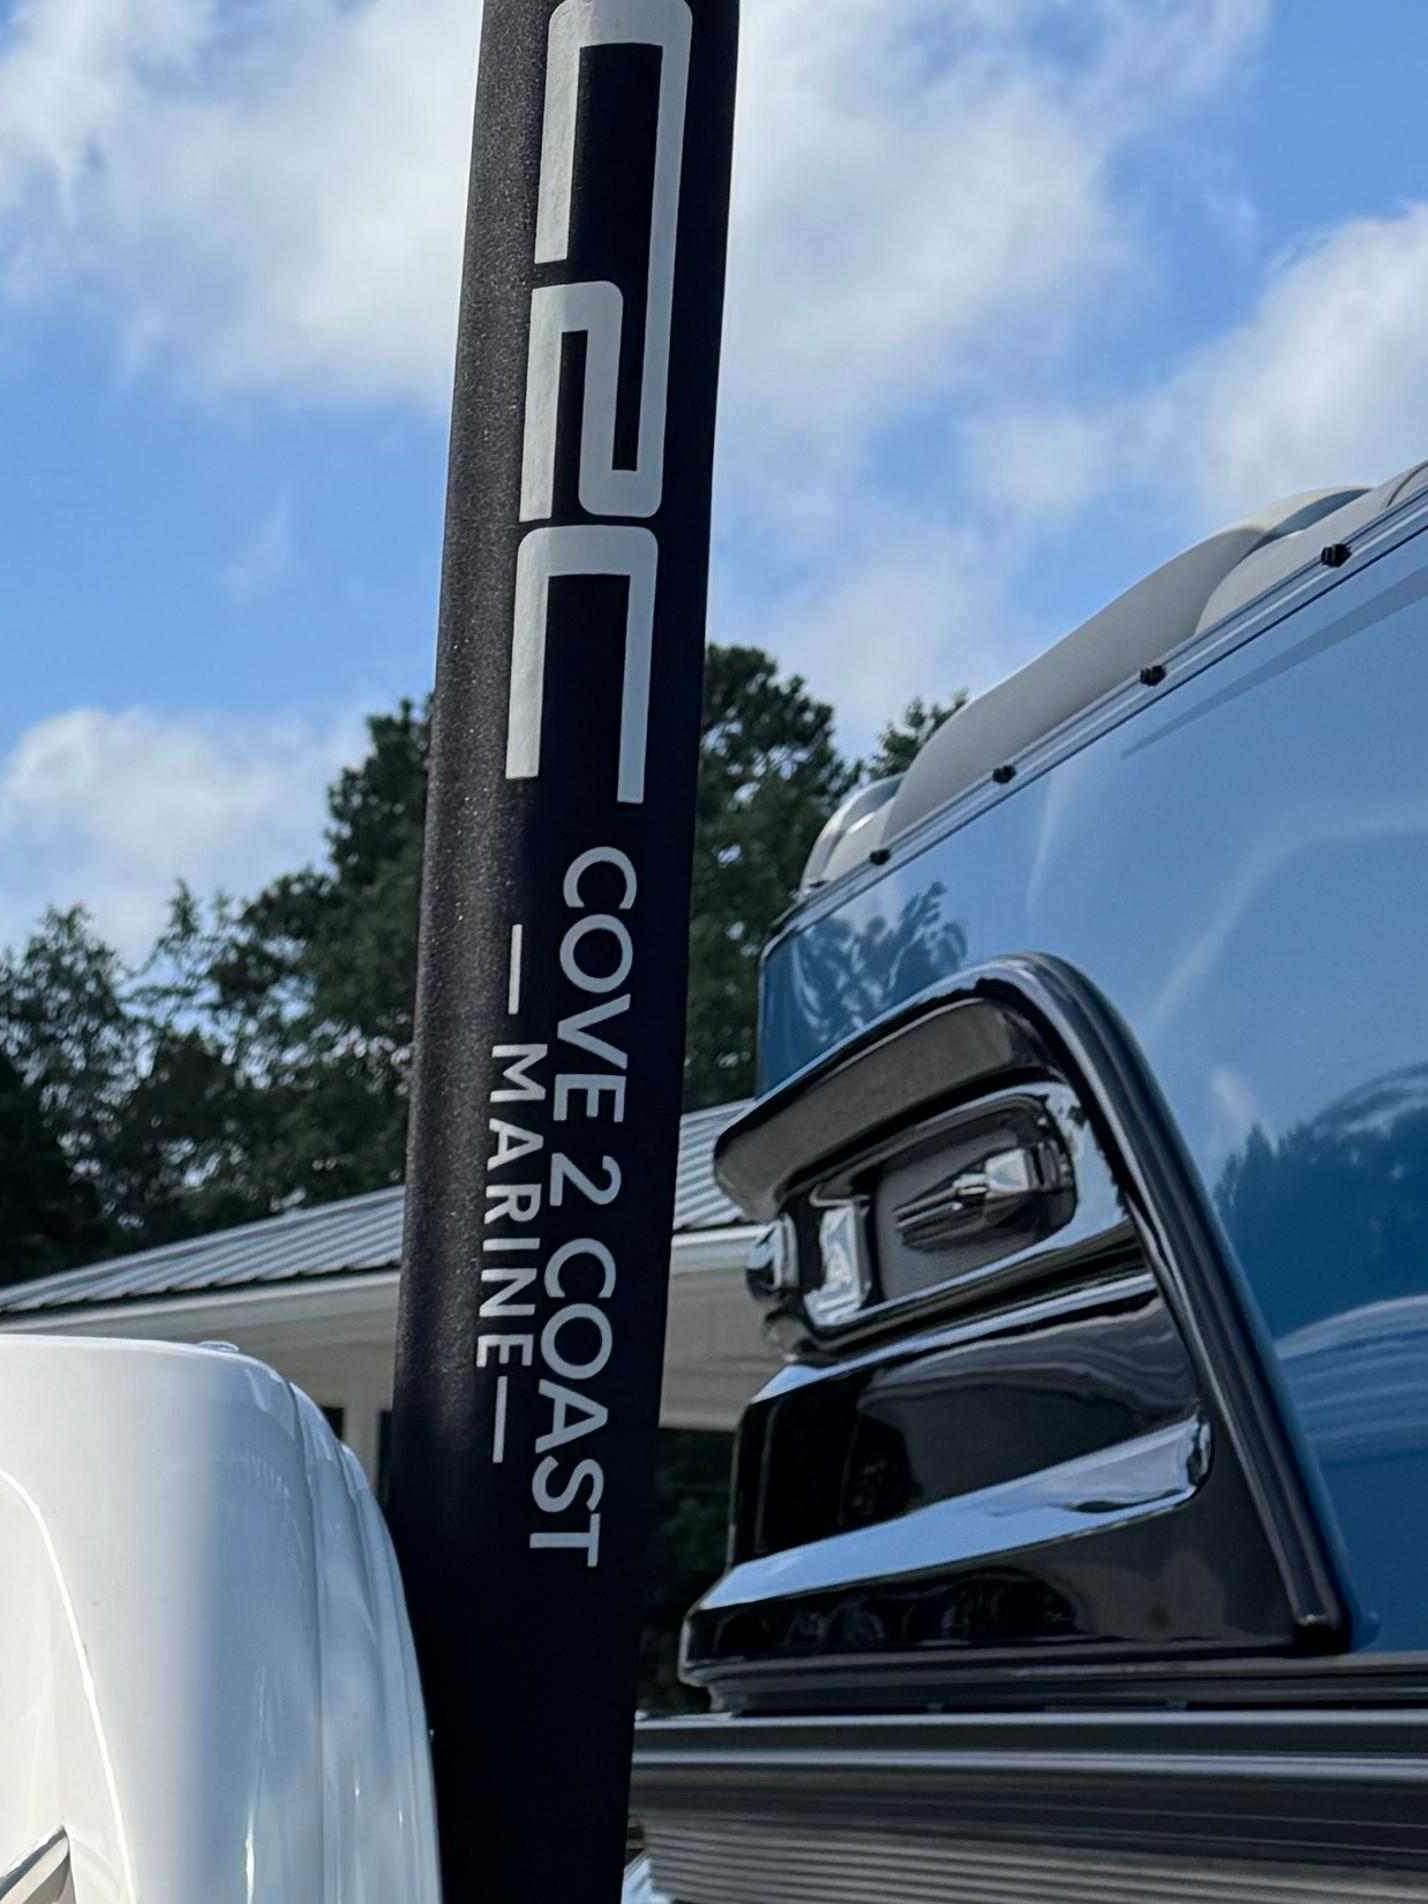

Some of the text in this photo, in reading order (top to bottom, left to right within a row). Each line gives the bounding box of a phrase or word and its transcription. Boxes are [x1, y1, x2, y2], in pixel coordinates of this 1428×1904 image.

[476, 1043, 548, 1368] MARINE
[529, 845, 638, 1568] COVE 2 COAST
